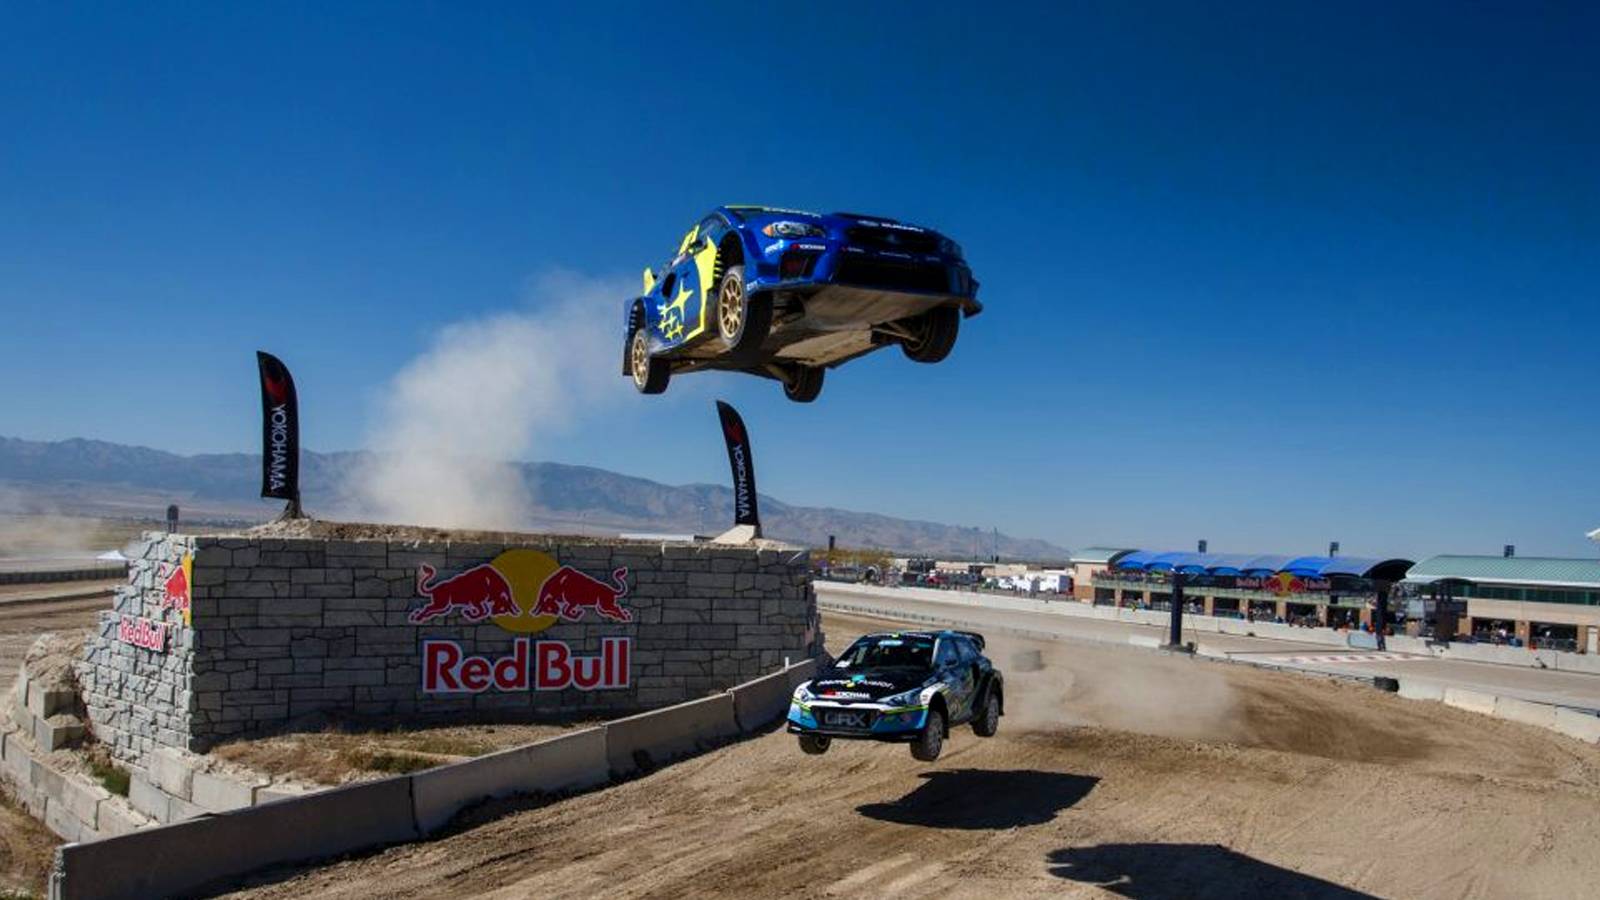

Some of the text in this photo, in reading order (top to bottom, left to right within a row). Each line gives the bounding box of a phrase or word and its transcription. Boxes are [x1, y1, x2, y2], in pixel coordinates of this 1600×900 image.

[270, 404, 287, 491] YOKOHAMA
[733, 444, 750, 518] YOKOHAMA
[424, 638, 629, 690] Red Bull
